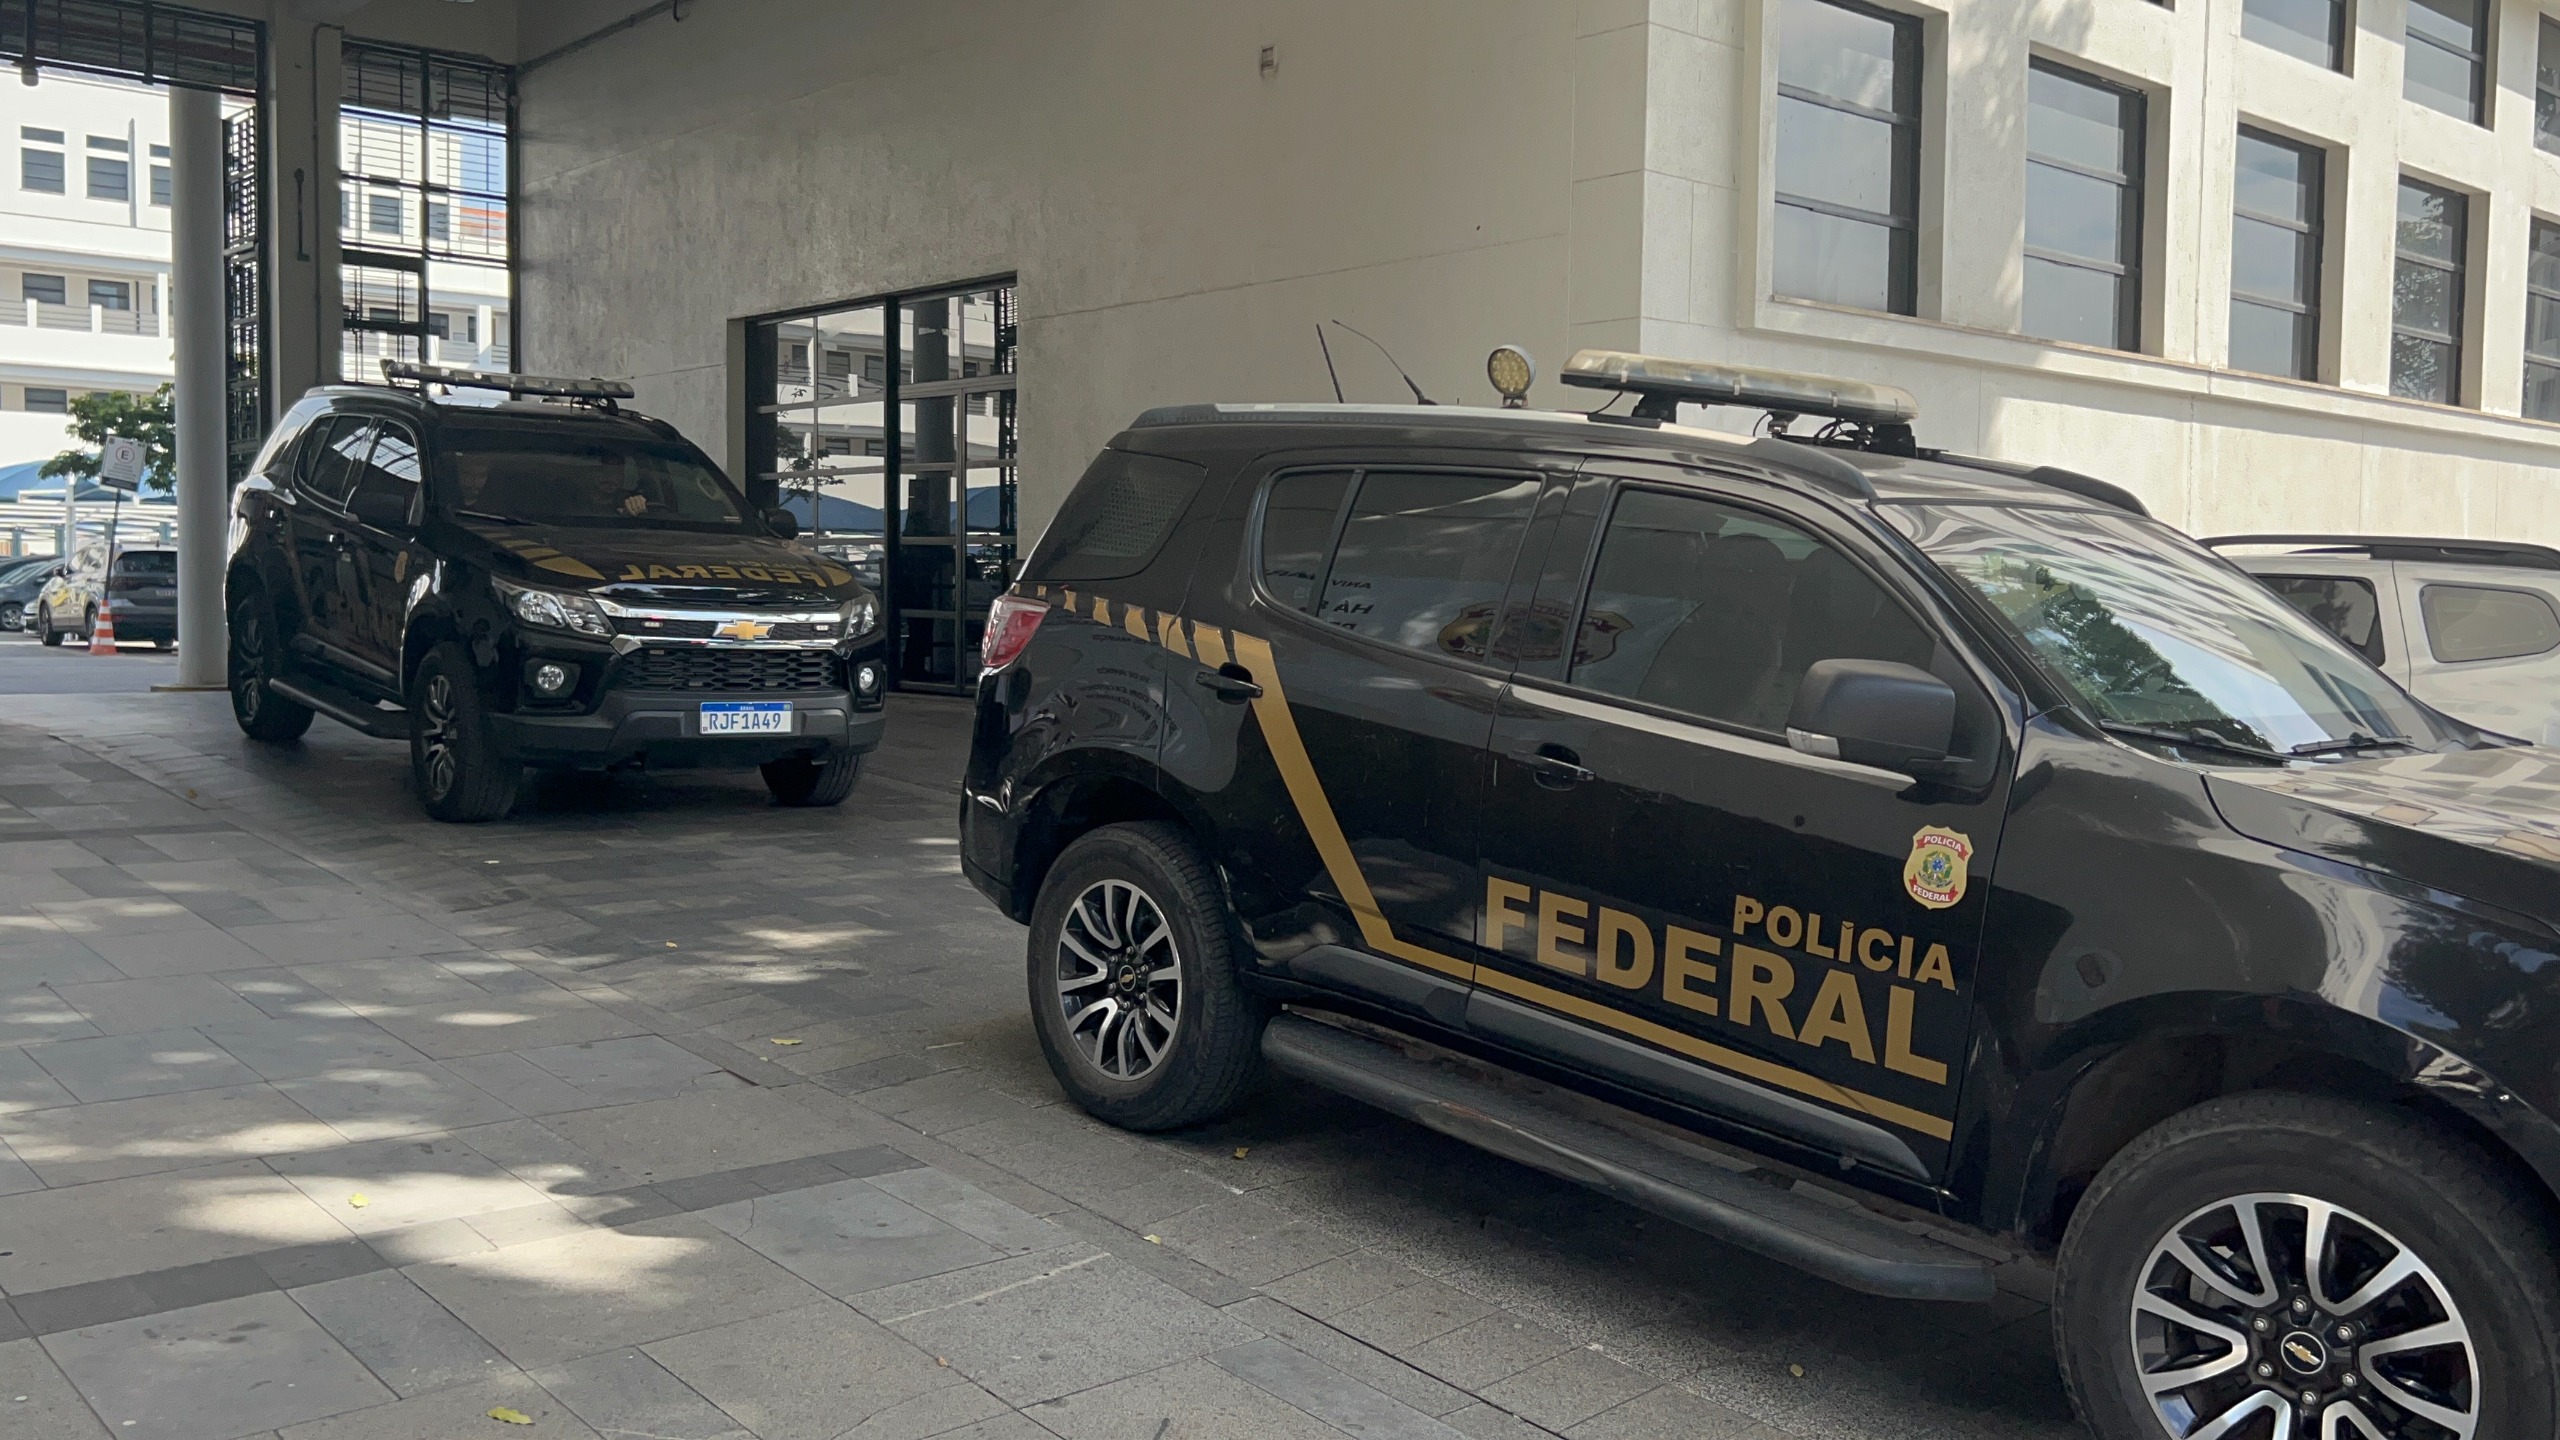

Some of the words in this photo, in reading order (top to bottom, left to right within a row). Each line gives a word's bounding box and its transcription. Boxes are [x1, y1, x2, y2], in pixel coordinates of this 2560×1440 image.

[121, 449, 130, 461] E
[709, 713, 782, 730] RJF1A49
[1913, 885, 1951, 902] FEDERAL
[1733, 894, 1956, 991] POLÍCIA
[1486, 876, 1947, 1086] FEDERAL
